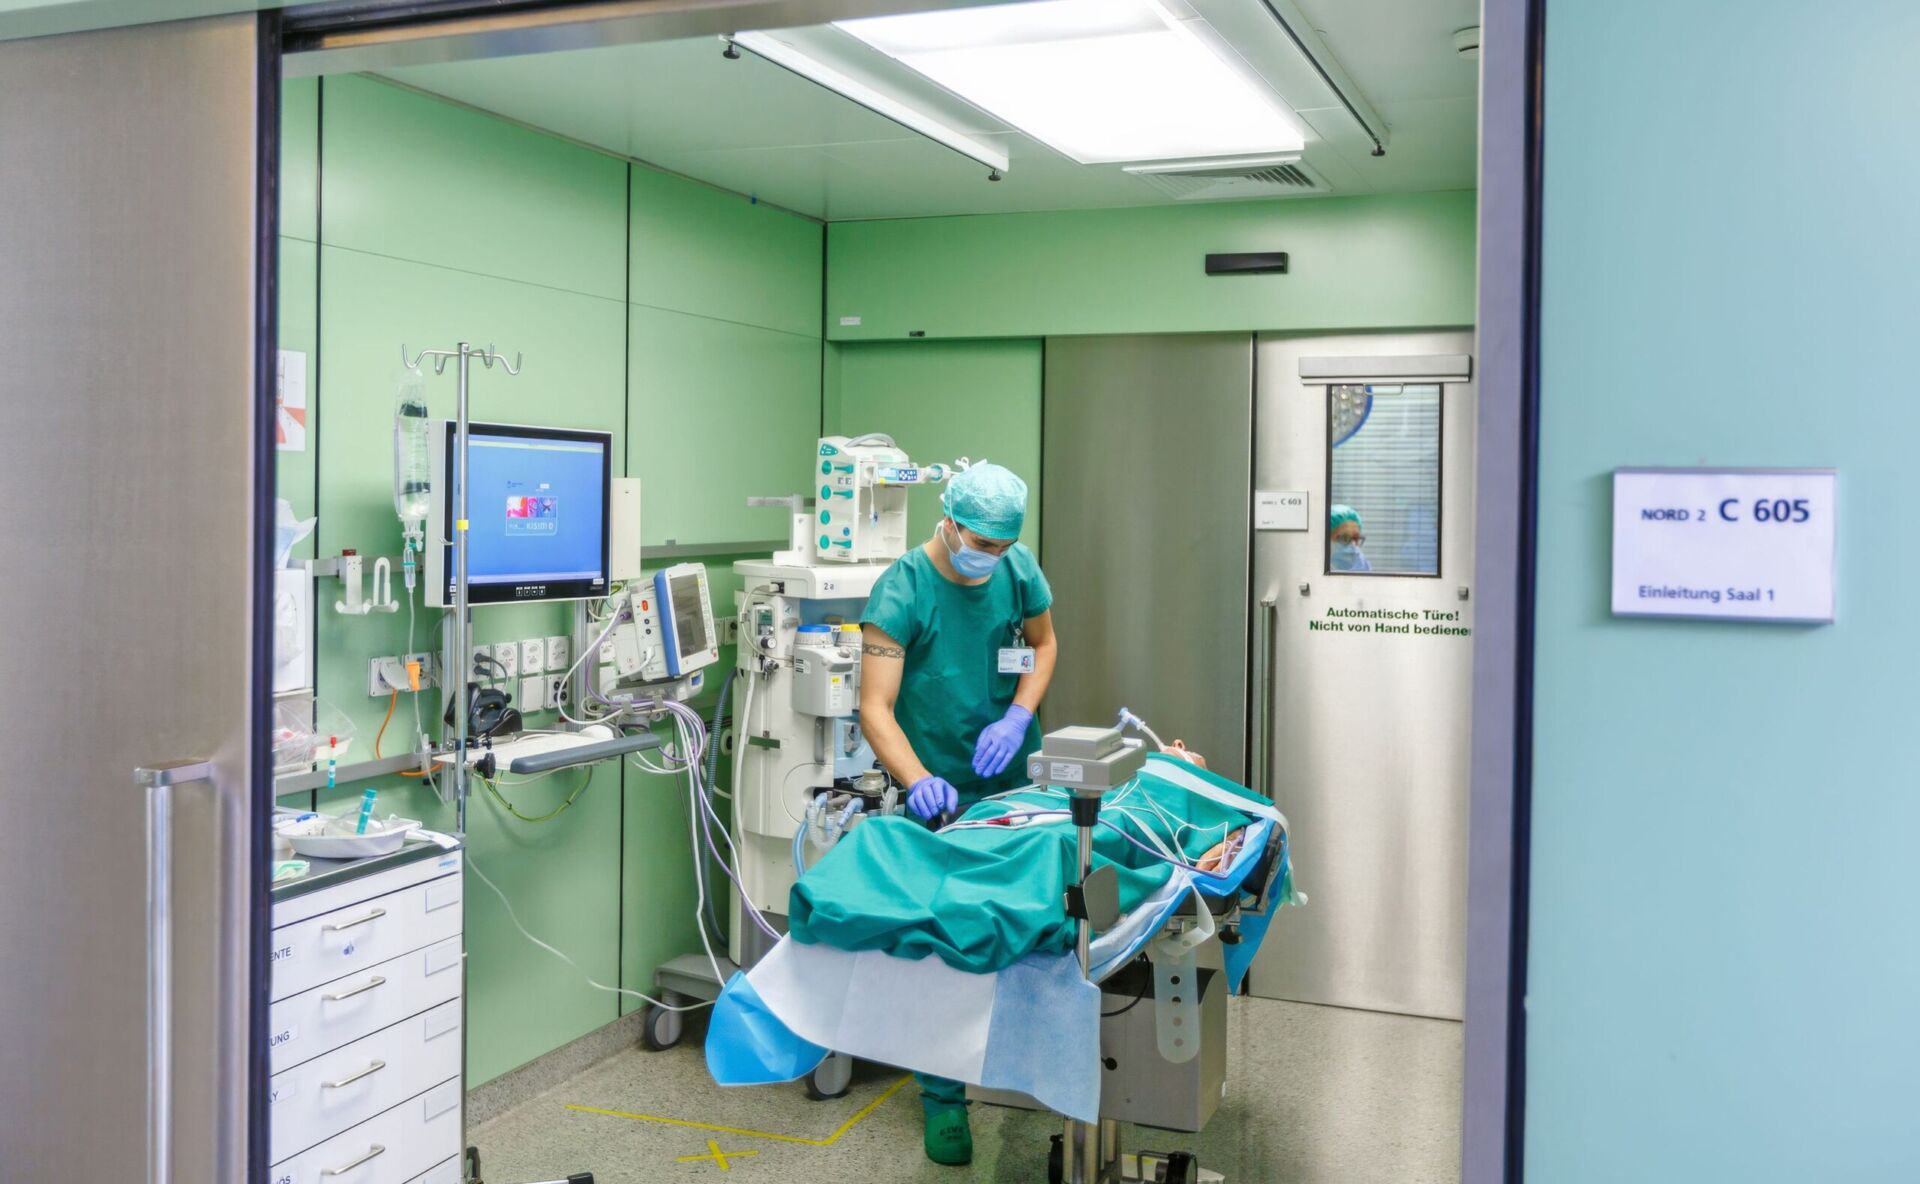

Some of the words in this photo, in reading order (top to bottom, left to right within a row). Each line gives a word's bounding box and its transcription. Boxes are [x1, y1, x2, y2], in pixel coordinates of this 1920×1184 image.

[1641, 508, 1690, 522] NORD
[1696, 509, 1706, 521] 2
[1719, 498, 1739, 522] C
[1753, 498, 1810, 523] 605
[1638, 585, 1721, 603] Einleitung
[1727, 587, 1760, 601] Saal
[1767, 589, 1775, 601] 1
[1326, 607, 1419, 620] Automatische
[1422, 609, 1460, 621] Türe!
[1309, 620, 1344, 632] Nicht
[1347, 624, 1371, 633] von
[1375, 623, 1410, 634] Hand
